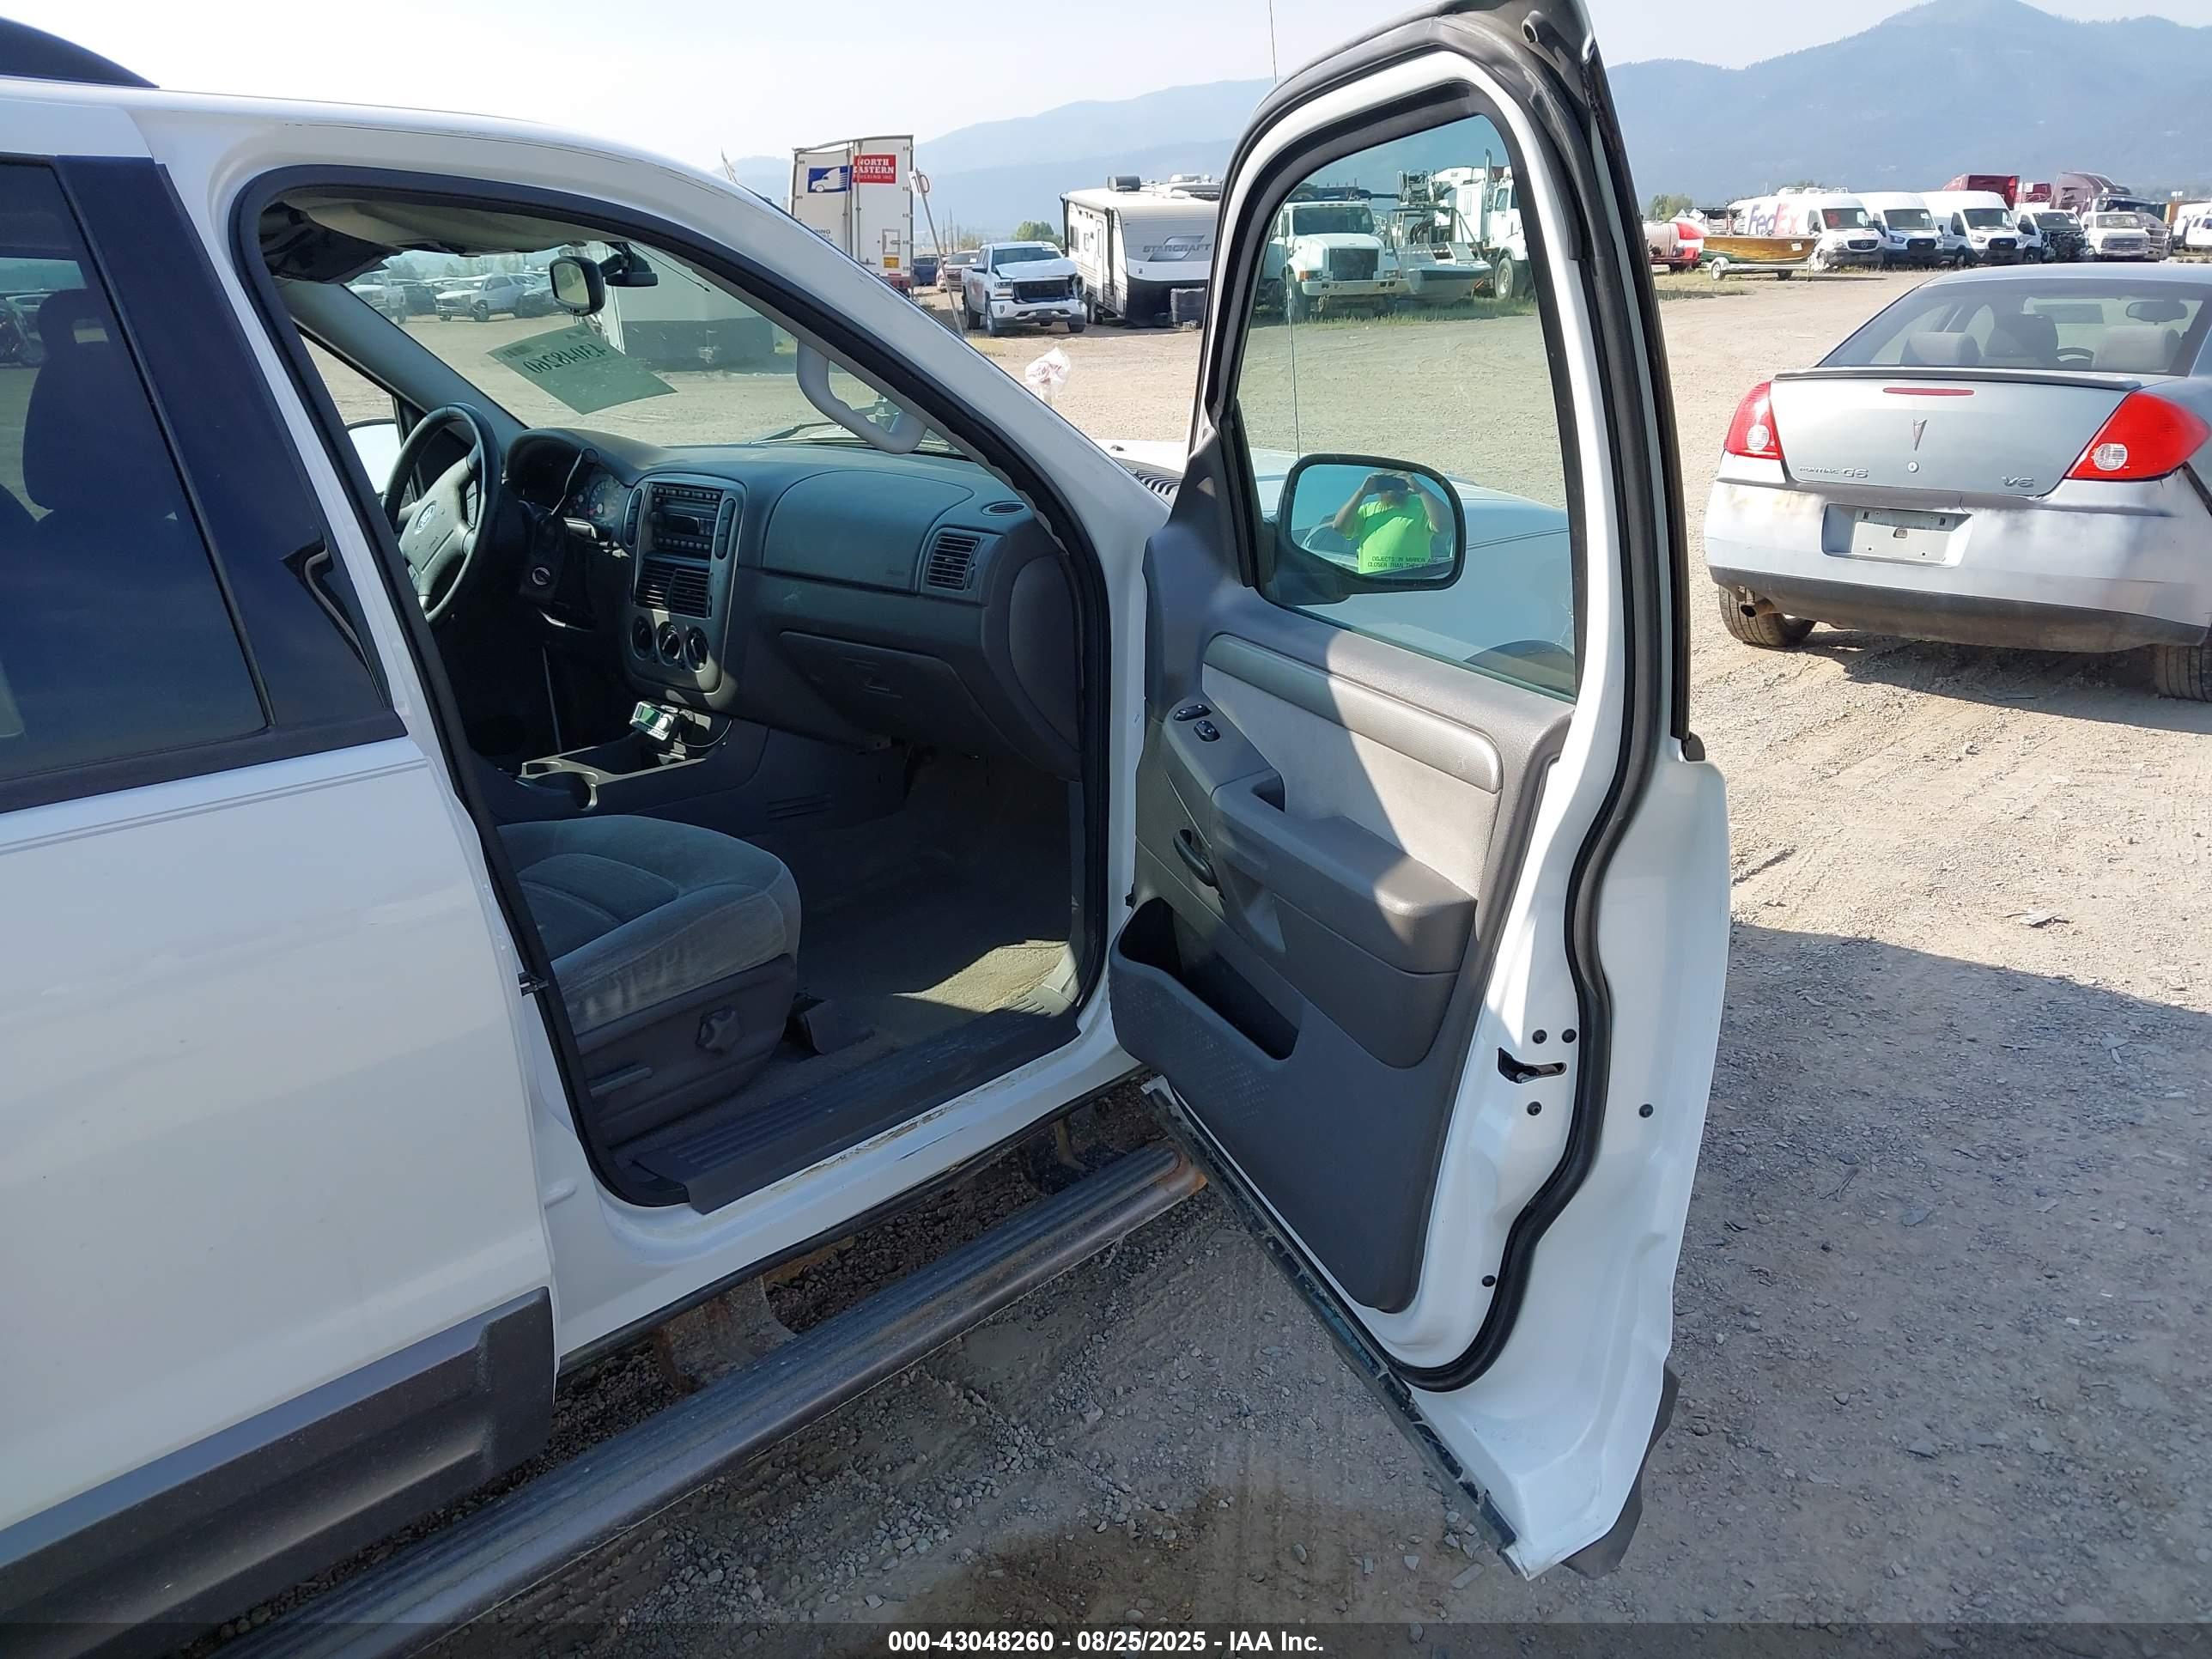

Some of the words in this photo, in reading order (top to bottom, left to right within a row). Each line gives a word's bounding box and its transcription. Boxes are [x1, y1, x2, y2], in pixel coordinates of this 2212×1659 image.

[853, 166, 895, 174] EASTERN
[1747, 203, 1800, 234] FedEx
[1143, 243, 1212, 252] STARCRAFT
[1842, 467, 1869, 478] G6
[2001, 476, 2034, 489] V6
